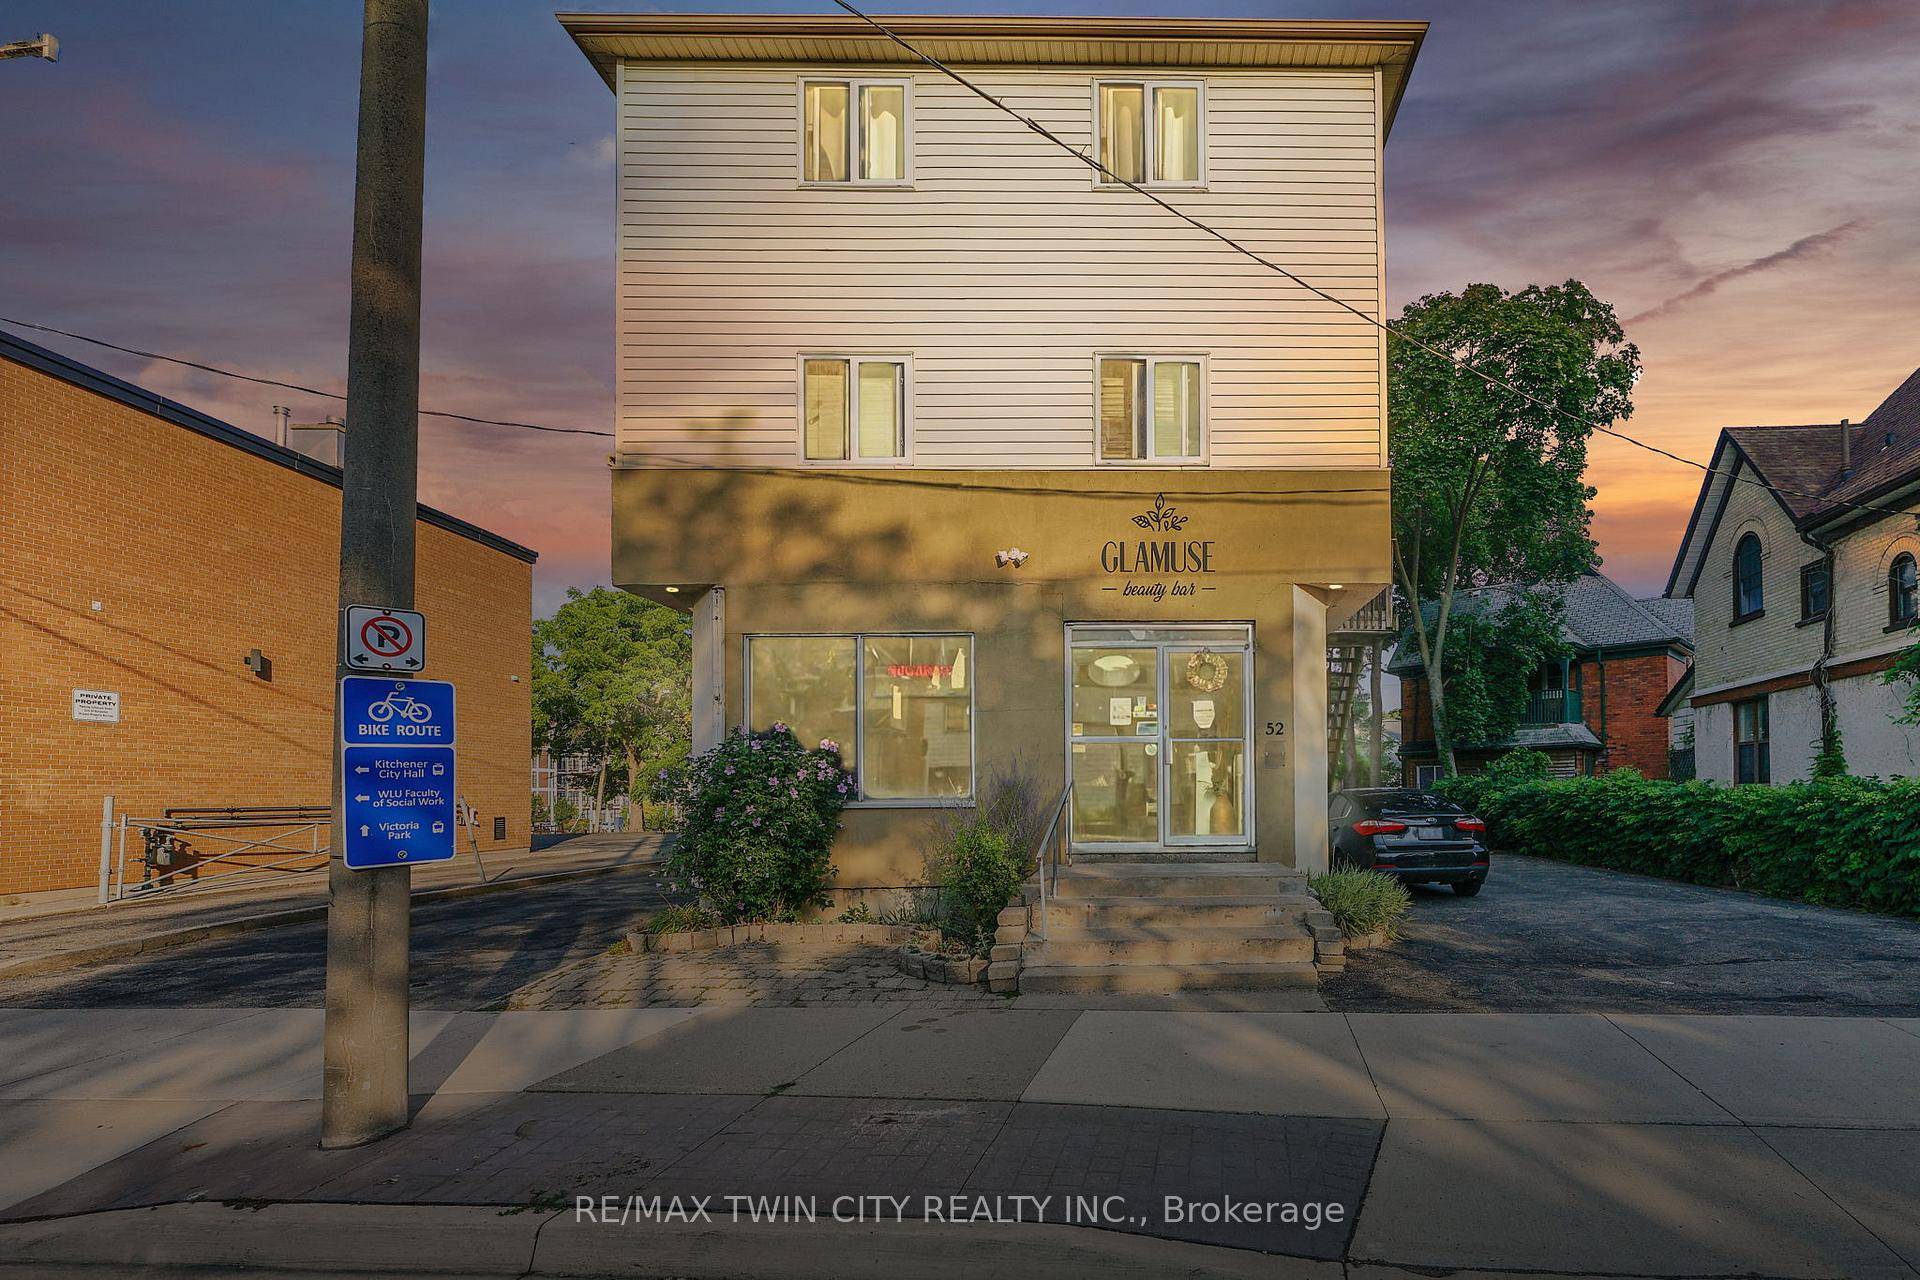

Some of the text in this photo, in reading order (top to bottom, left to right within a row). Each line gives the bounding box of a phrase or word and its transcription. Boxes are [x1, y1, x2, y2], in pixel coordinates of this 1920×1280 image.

[1101, 541, 1216, 573] GLAMUSE
[1122, 580, 1197, 603] beauty bar
[75, 698, 117, 706] PROPERTY
[79, 693, 112, 701] PRIVATE
[358, 724, 442, 737] BIKE ROUTE
[1265, 722, 1284, 736] 52
[375, 759, 429, 769] Kitchener
[378, 769, 424, 780] City Hall
[377, 788, 440, 799] WLU Faculty
[372, 796, 445, 808] of Social Work
[378, 821, 420, 831] Victoria
[388, 831, 412, 840] Park
